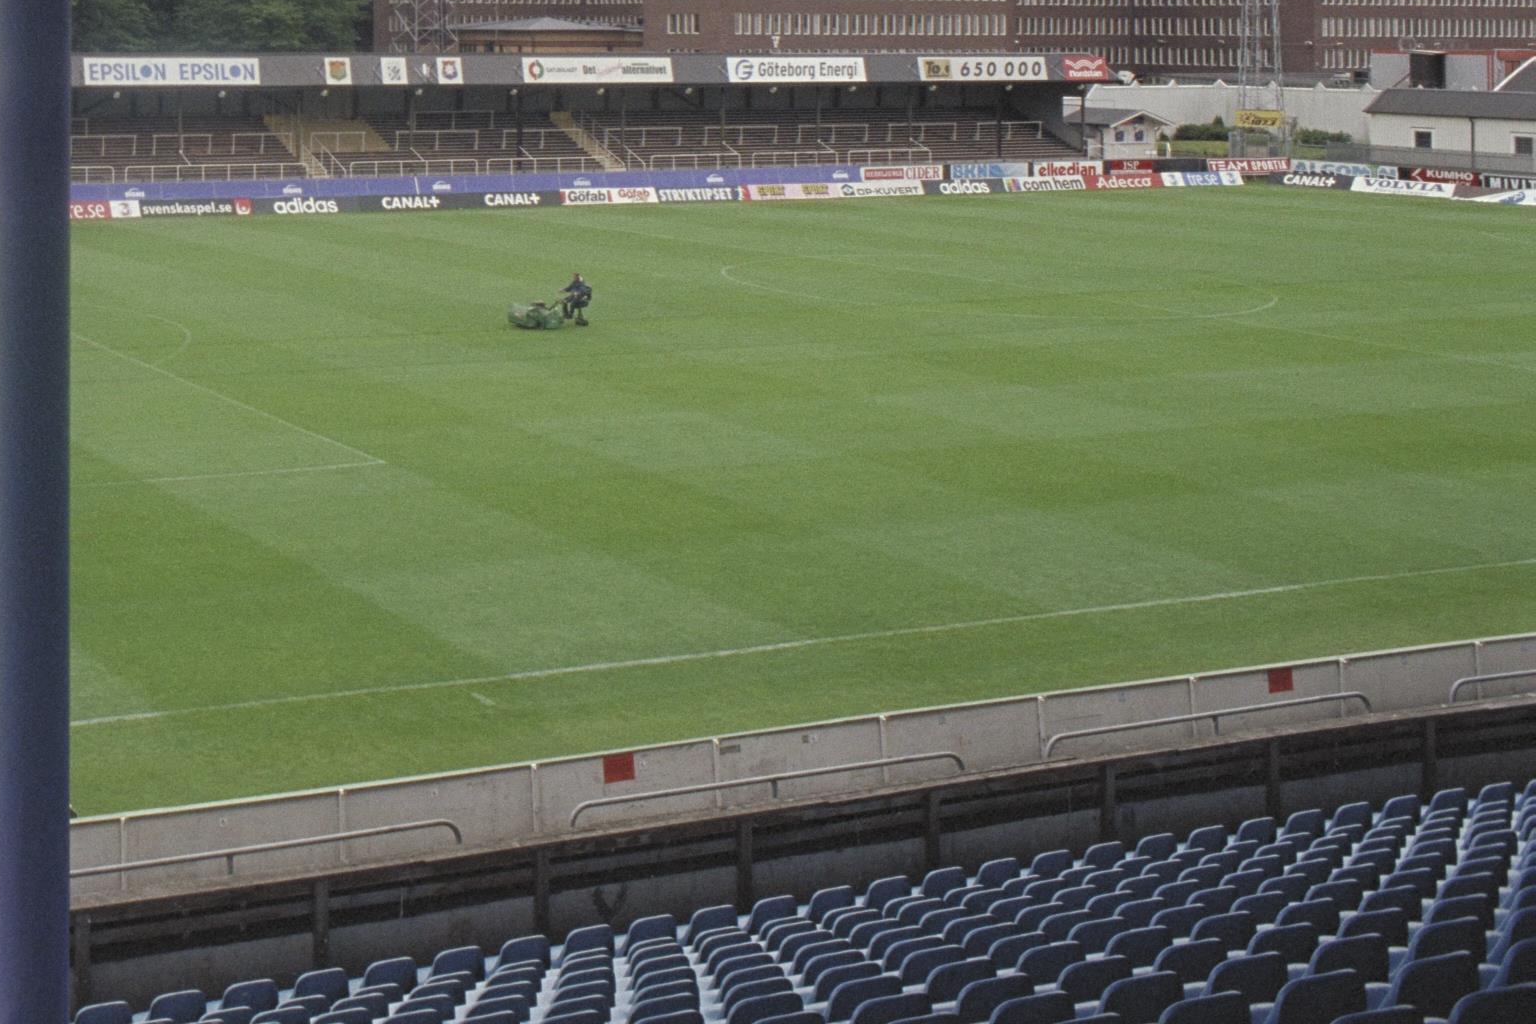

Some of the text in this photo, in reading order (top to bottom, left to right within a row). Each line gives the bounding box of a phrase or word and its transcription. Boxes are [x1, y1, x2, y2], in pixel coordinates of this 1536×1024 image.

[758, 61, 858, 79] Göteborg Energi
[1038, 162, 1097, 177] elkedian
[1122, 161, 1140, 170] ISP
[1209, 160, 1248, 171] TEAM
[906, 167, 940, 180] CIDER
[1283, 174, 1336, 187] CANAL+
[1426, 169, 1473, 181] KUMHO
[940, 178, 990, 194] adidas
[1096, 175, 1152, 188] Adecco
[1365, 178, 1445, 192] VOLVIA
[484, 192, 541, 206] CANAL+
[568, 190, 607, 202] Göfab
[659, 187, 732, 202] STRYKTIPSET
[143, 202, 233, 216] svenskaspel.se
[274, 197, 338, 214] adidas
[382, 196, 441, 210] CANAL+
